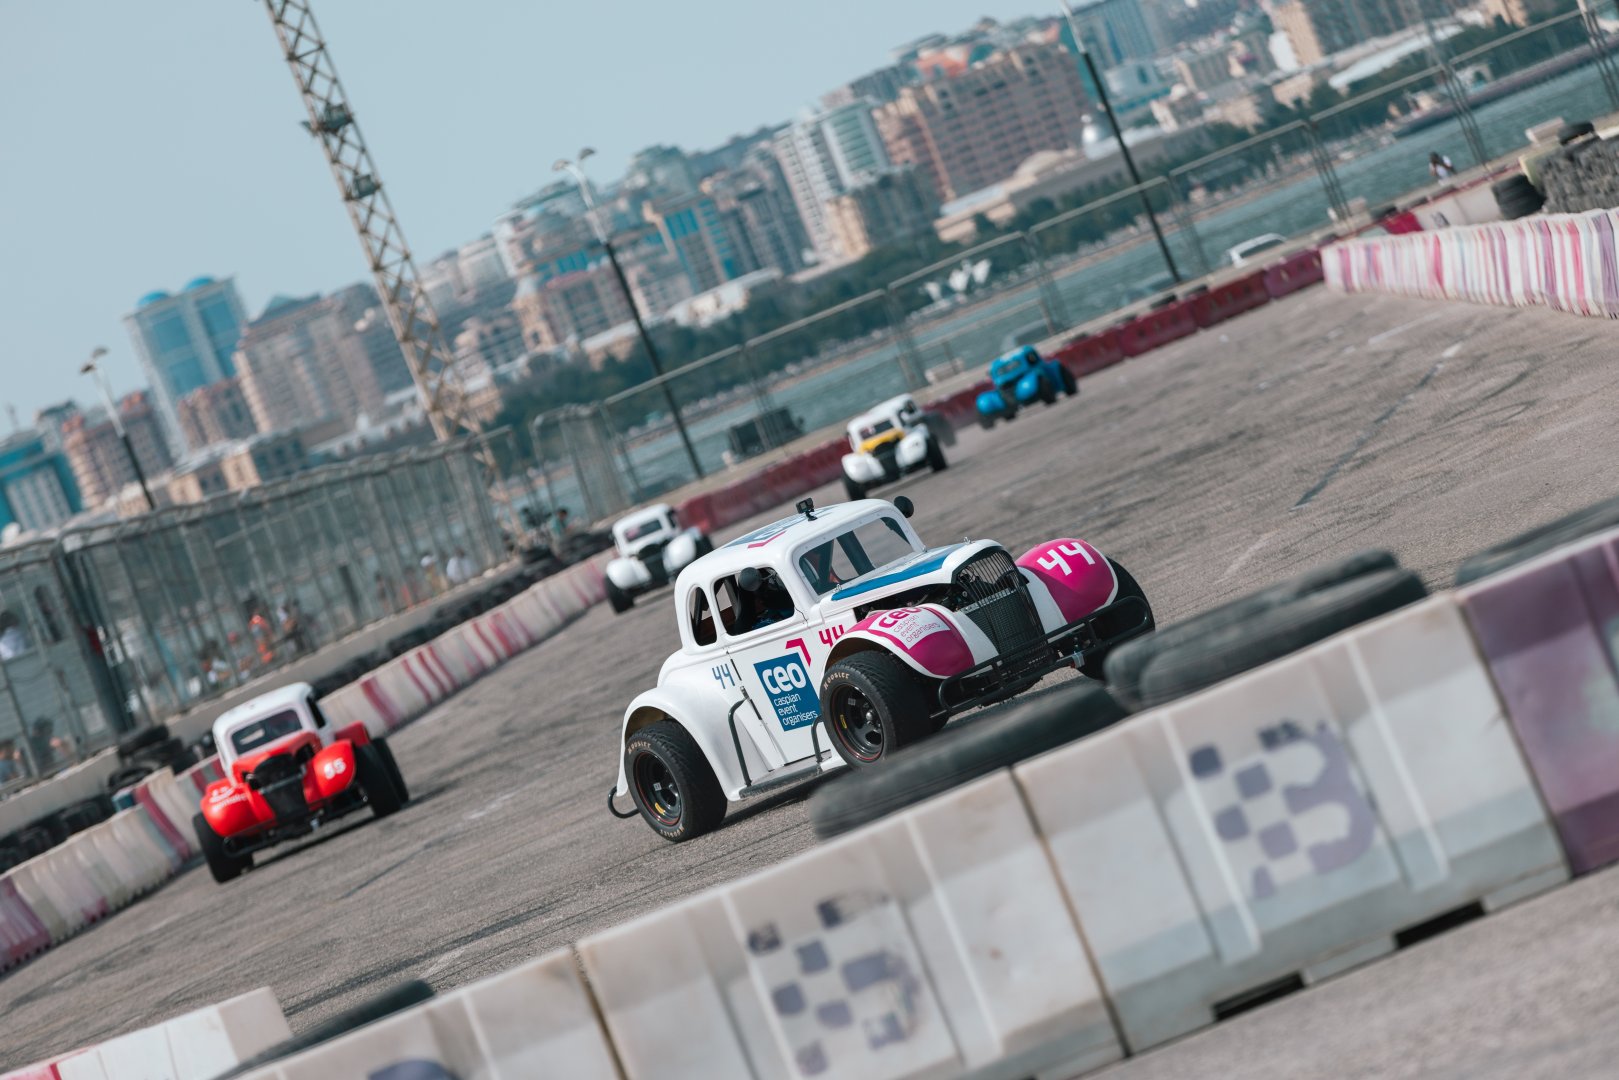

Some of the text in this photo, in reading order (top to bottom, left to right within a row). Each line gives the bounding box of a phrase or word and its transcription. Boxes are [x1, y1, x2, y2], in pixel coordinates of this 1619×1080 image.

[1036, 542, 1095, 576] 44
[900, 621, 920, 637] event
[711, 663, 735, 690] 44
[762, 662, 807, 695] ceo
[773, 693, 801, 707] caspian
[778, 704, 798, 716] event
[782, 710, 818, 726] organisers
